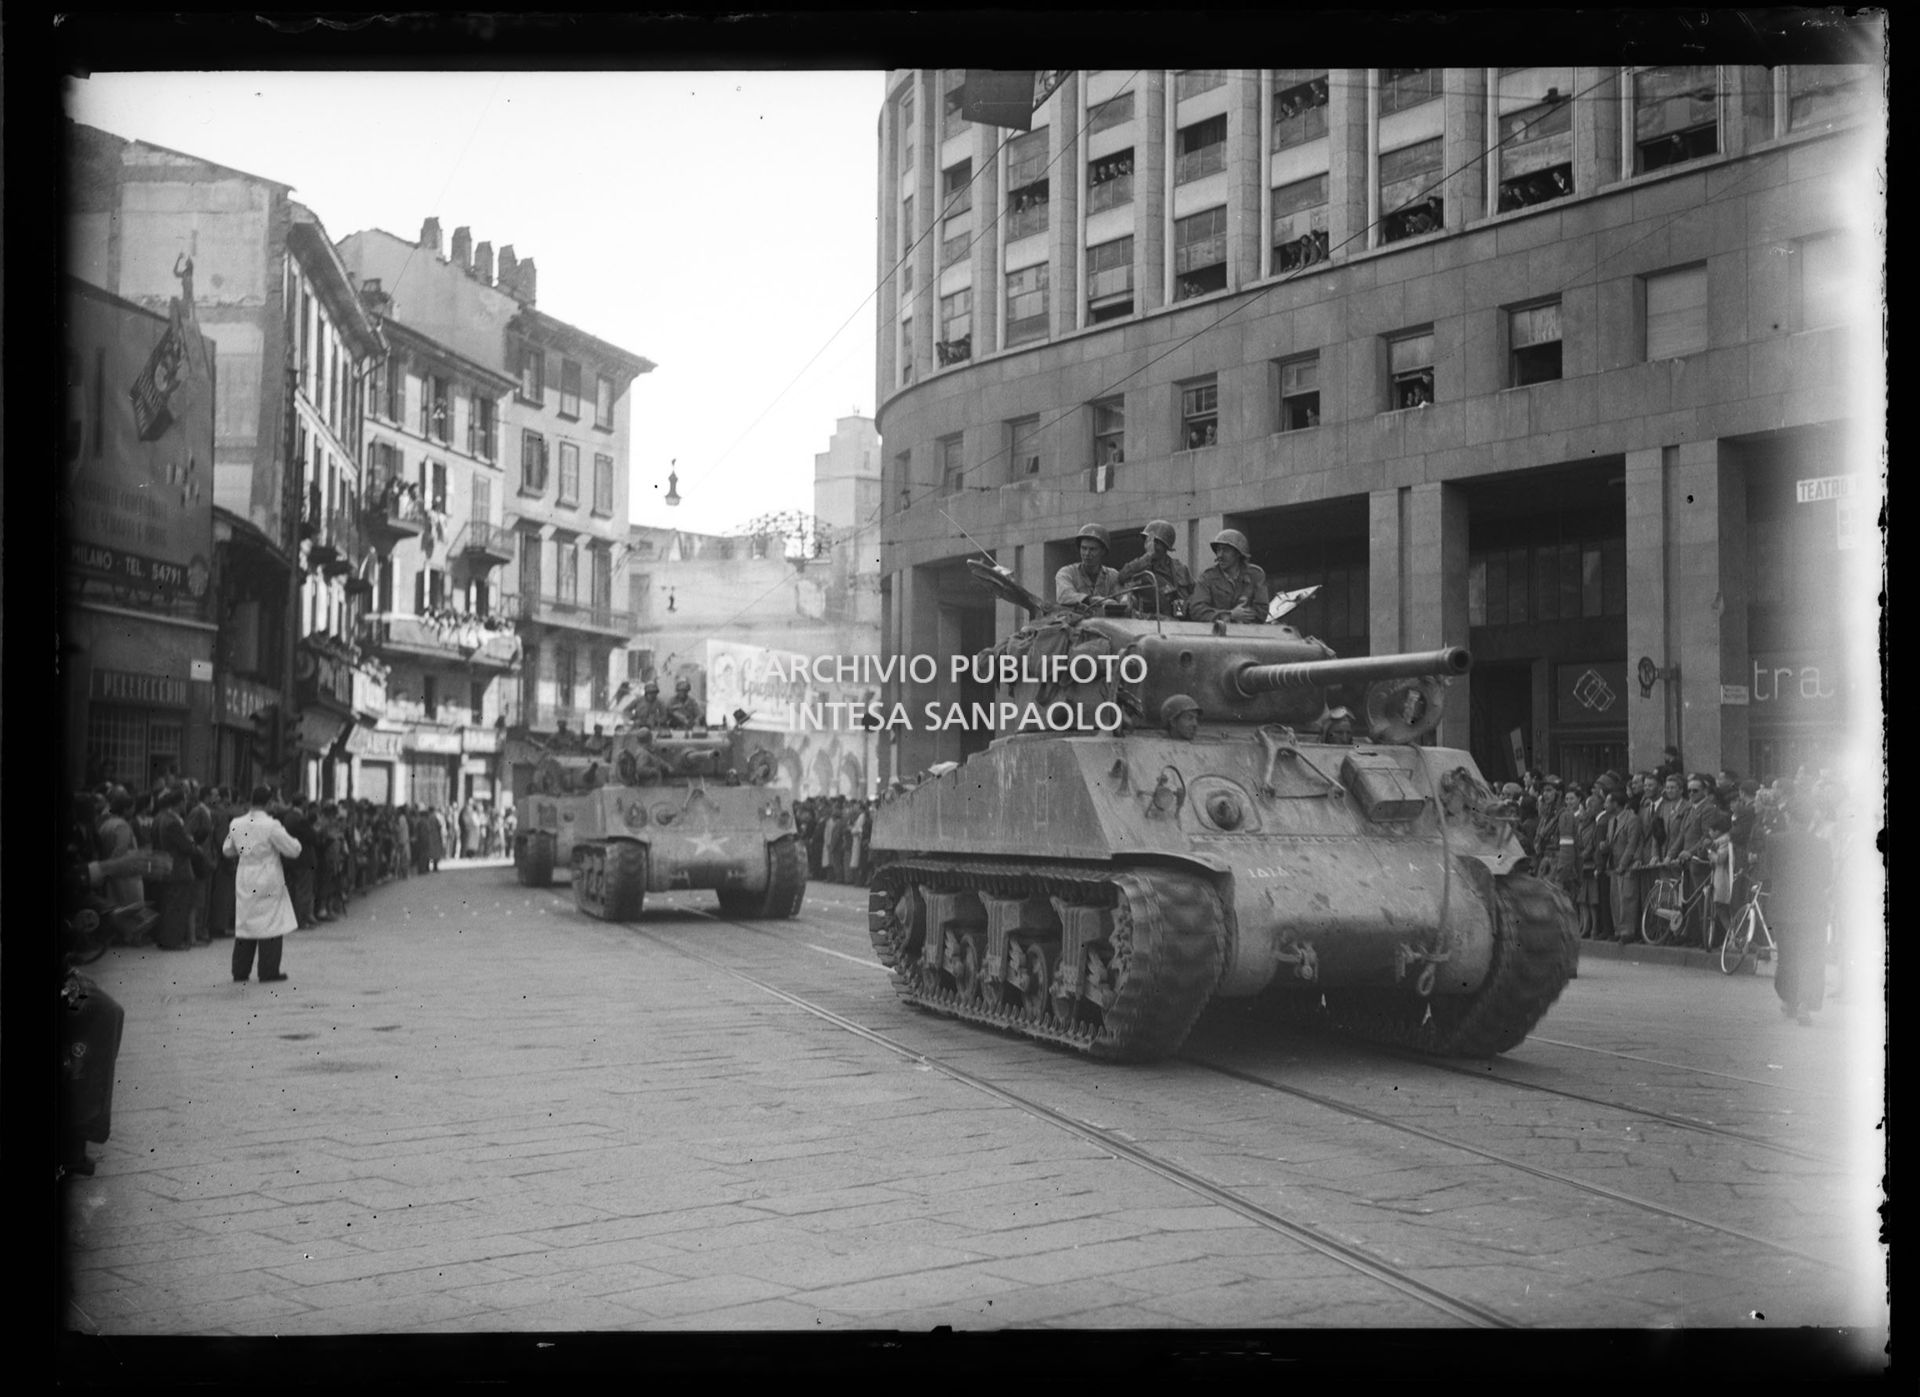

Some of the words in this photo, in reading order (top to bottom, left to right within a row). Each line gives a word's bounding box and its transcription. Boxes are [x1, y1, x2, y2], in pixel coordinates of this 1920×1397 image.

[1799, 478, 1848, 500] TEATRO
[72, 544, 113, 570] MILANO
[125, 556, 146, 577] TEL.
